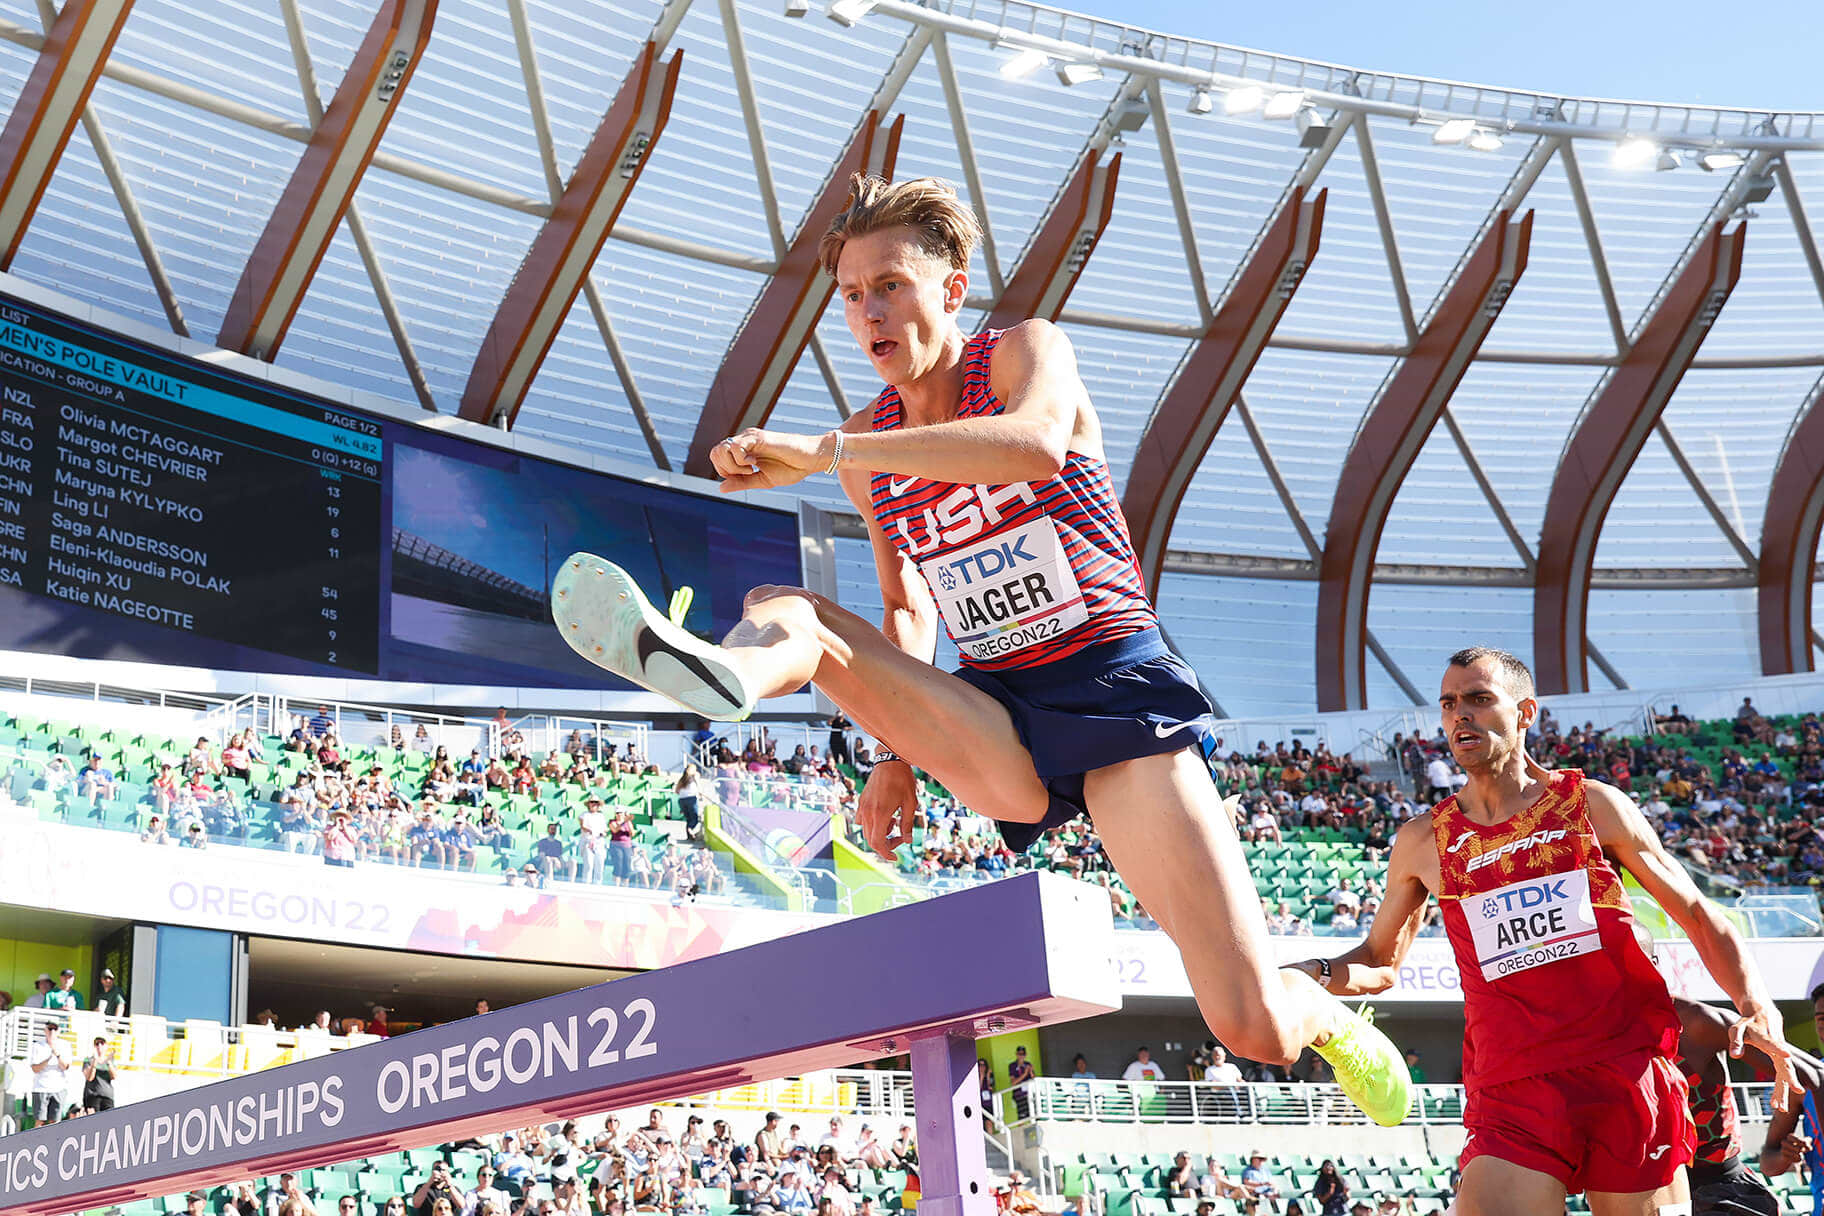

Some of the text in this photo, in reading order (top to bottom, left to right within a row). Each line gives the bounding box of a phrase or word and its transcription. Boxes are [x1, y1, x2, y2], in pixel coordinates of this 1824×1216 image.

[1, 307, 30, 326] LIST
[0, 352, 56, 379] ICATION
[66, 374, 113, 396] GROUP
[114, 390, 126, 402] A
[62, 347, 115, 377] POLE
[121, 366, 189, 401] VAULT
[4, 386, 36, 409] NZL
[2, 408, 34, 430] FRA
[324, 412, 378, 436] PAGE 1/2
[0, 430, 34, 451] SLO
[60, 405, 224, 466] Olivia MCTAGGART
[332, 433, 350, 447] WL
[0, 453, 31, 473] UKR
[57, 446, 152, 487] Tina SUTEJ
[58, 425, 208, 482] Margot CHEVRIER
[322, 451, 339, 467] (Q)
[342, 458, 361, 471] +12
[0, 475, 32, 497] CHN
[55, 468, 204, 522] Maryna KYLYPKO
[327, 487, 341, 498] 13
[53, 490, 109, 518] Ling LI
[326, 506, 340, 517] 19
[896, 481, 1038, 556] USA
[52, 512, 208, 567] Saga ANDERSSON
[331, 528, 340, 538] 6
[0, 545, 27, 564] HN
[50, 534, 231, 595] Eleni-Klaoudia POLAK
[328, 547, 339, 559] 11
[950, 534, 1038, 585] TDK
[48, 557, 132, 592] Huiqin XU
[46, 579, 194, 630] Katie NAGEOTTE
[322, 587, 338, 600] 54
[955, 572, 1055, 632] JAGER
[321, 607, 337, 621] 45
[328, 630, 337, 641] 9
[971, 618, 1064, 659] OREGON22
[328, 651, 337, 663] 2
[1497, 879, 1569, 911] TDK
[1497, 907, 1566, 949] ARCE
[1497, 942, 1580, 974] OREGON22
[57, 1074, 345, 1181] CHAMPIONSHIPS
